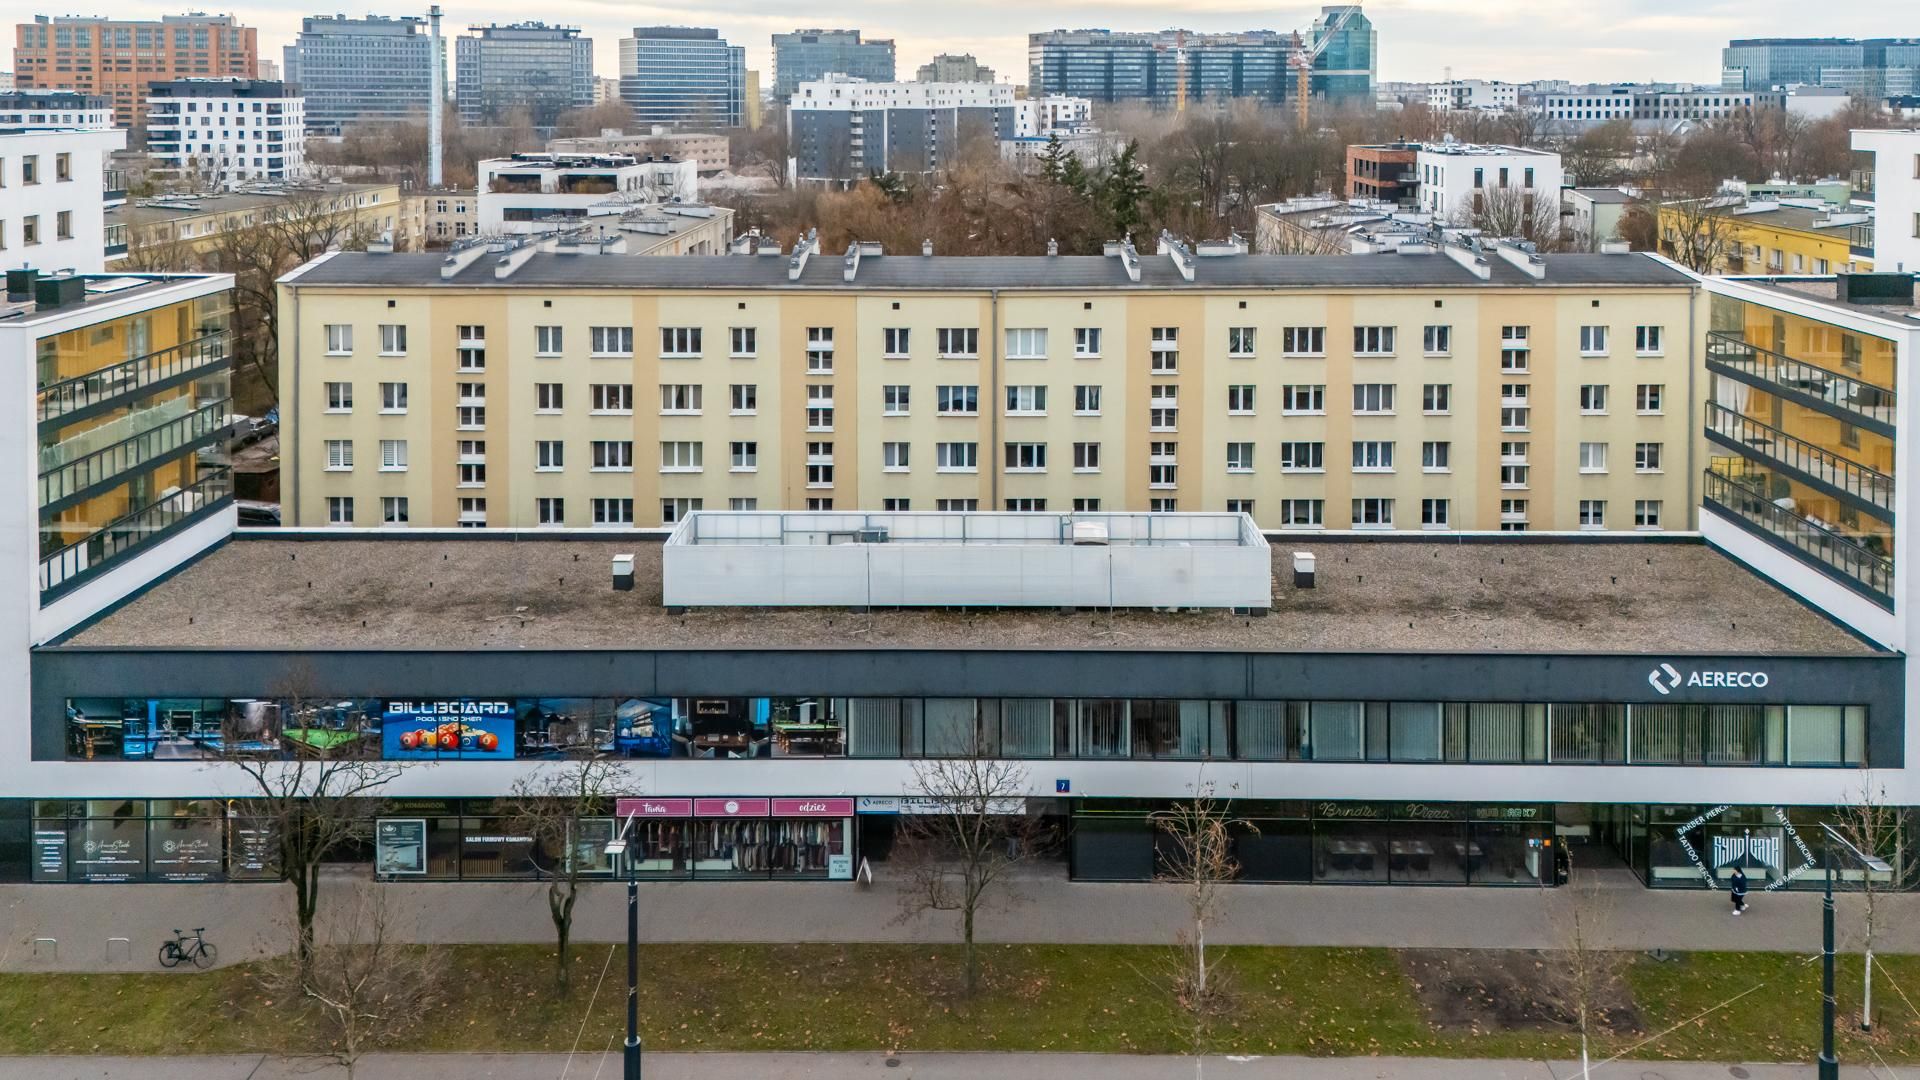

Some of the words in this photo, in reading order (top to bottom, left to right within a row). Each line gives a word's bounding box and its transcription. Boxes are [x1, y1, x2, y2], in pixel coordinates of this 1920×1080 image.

[1687, 671, 1769, 688] AERECO
[389, 702, 509, 714] BILLBOARD
[642, 802, 666, 814] tania
[1677, 816, 1706, 836] BARBER
[1775, 810, 1797, 836] TATTOO
[1793, 834, 1817, 866] PIERCING
[1678, 835, 1698, 862] TATTOO
[1695, 860, 1719, 892] PIERCING
[1782, 863, 1811, 882] BARBER
